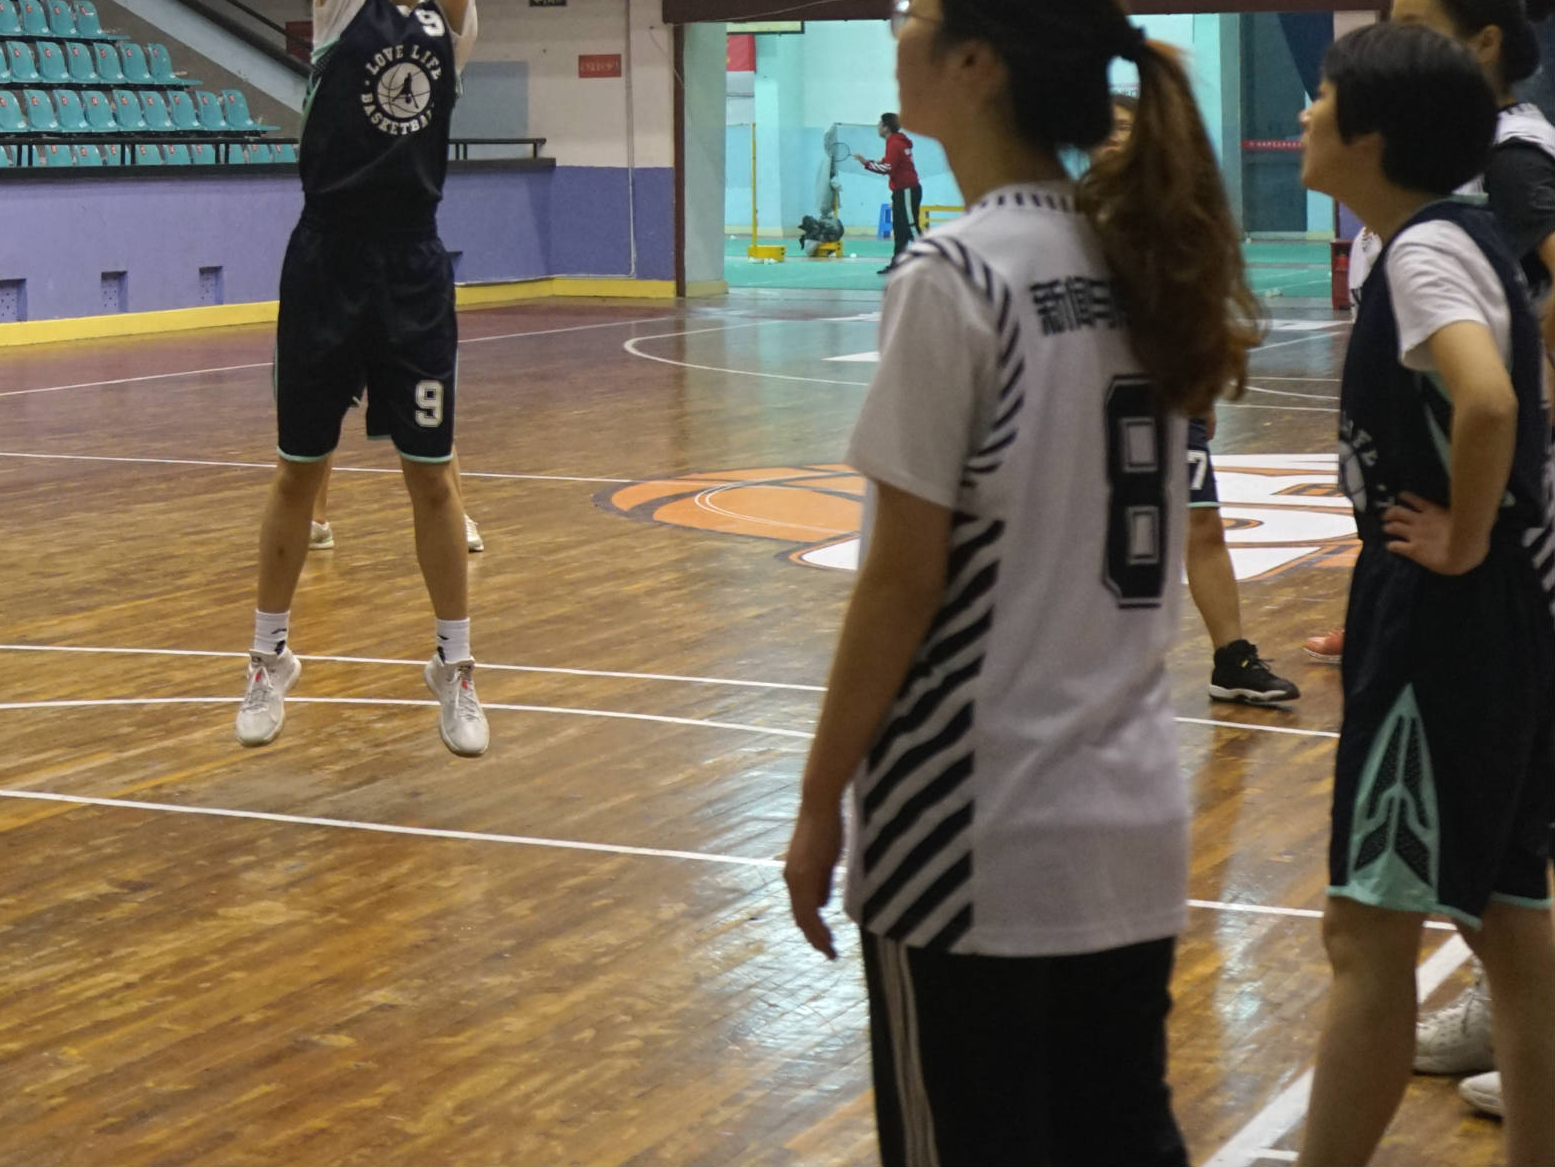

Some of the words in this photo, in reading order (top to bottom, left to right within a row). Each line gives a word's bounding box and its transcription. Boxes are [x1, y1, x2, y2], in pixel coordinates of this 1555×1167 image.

[365, 44, 404, 75] LOVE
[410, 44, 442, 80] LIFE
[414, 379, 444, 428] 9
[1101, 374, 1170, 610] 8
[1187, 449, 1207, 490] 7
